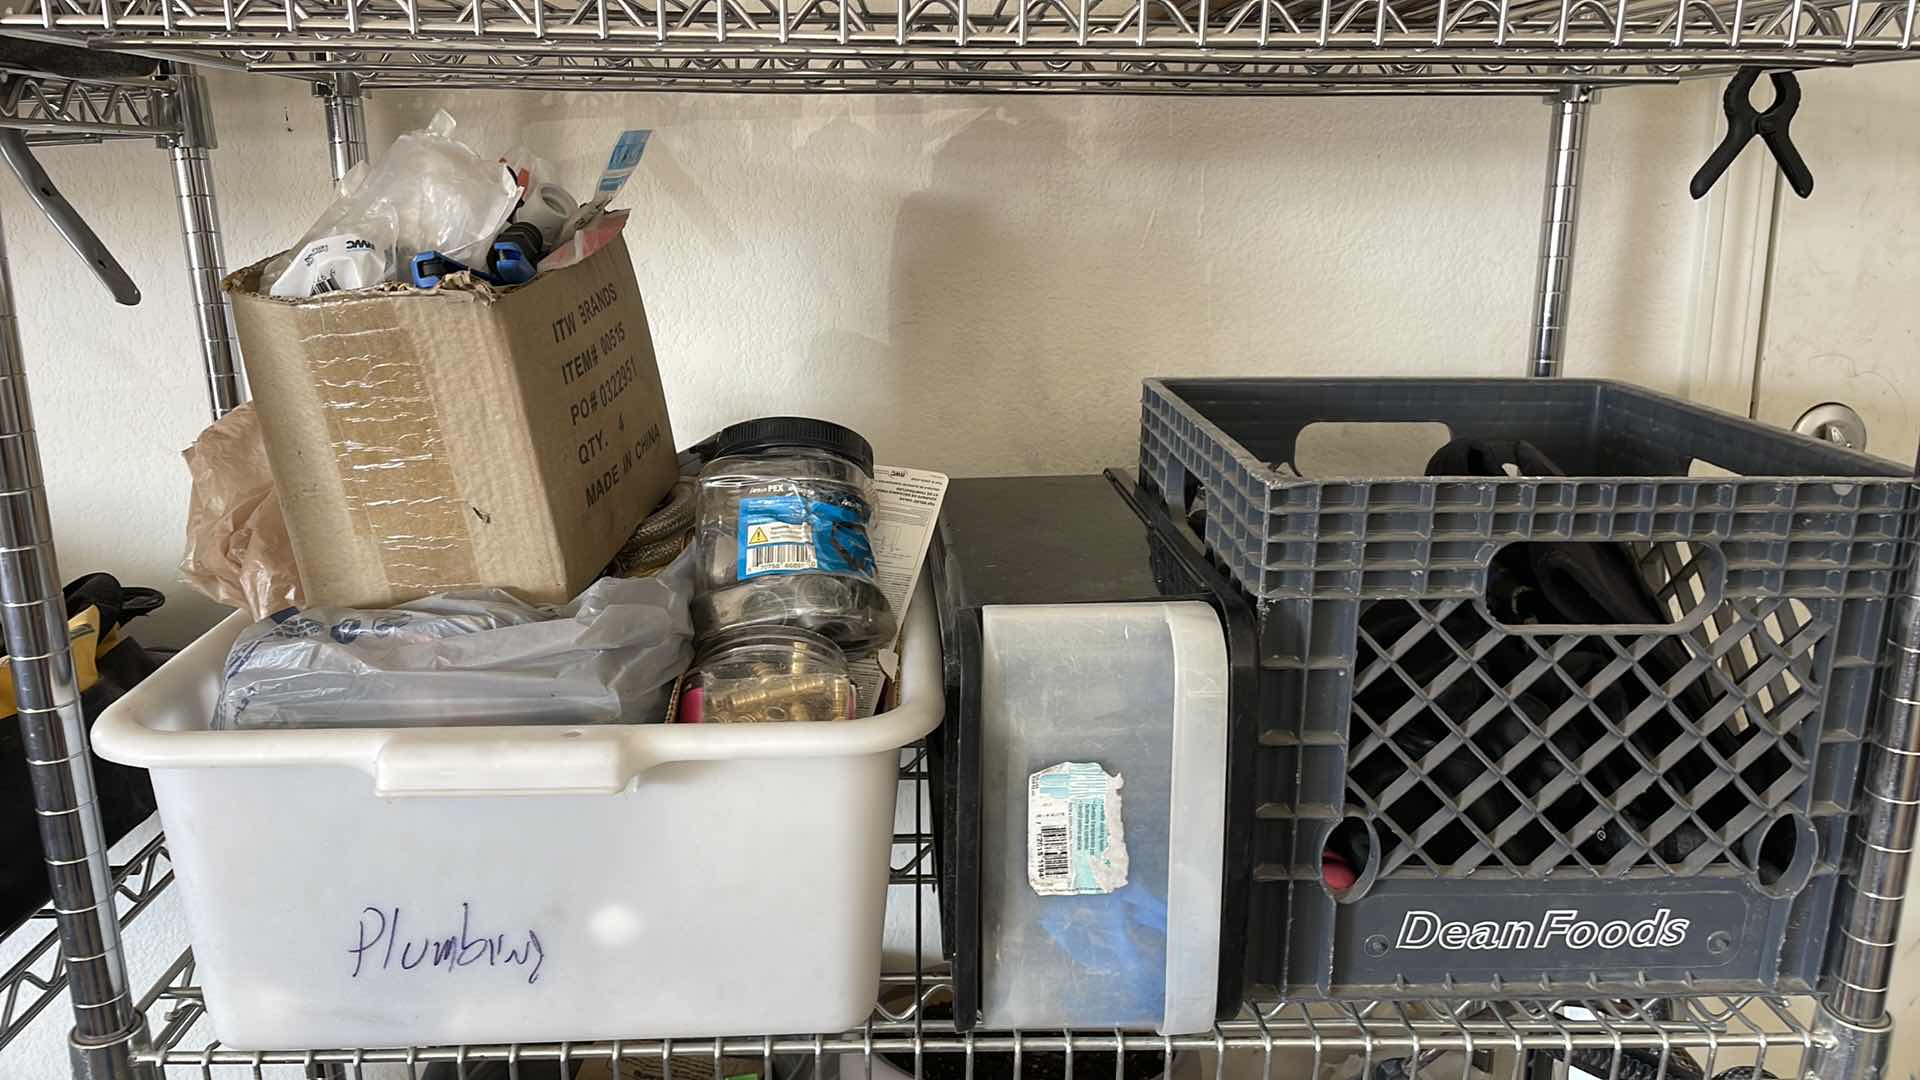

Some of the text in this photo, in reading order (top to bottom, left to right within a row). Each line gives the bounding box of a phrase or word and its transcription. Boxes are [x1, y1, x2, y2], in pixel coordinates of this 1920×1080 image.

[552, 282, 617, 343] ITW BRANDS
[561, 344, 599, 385] ITEM#
[570, 391, 598, 426] PO#
[578, 430, 608, 464] QTY.
[585, 423, 661, 508] MADE IN CHINA
[767, 484, 785, 494] PEX
[348, 902, 545, 984] Plumbing
